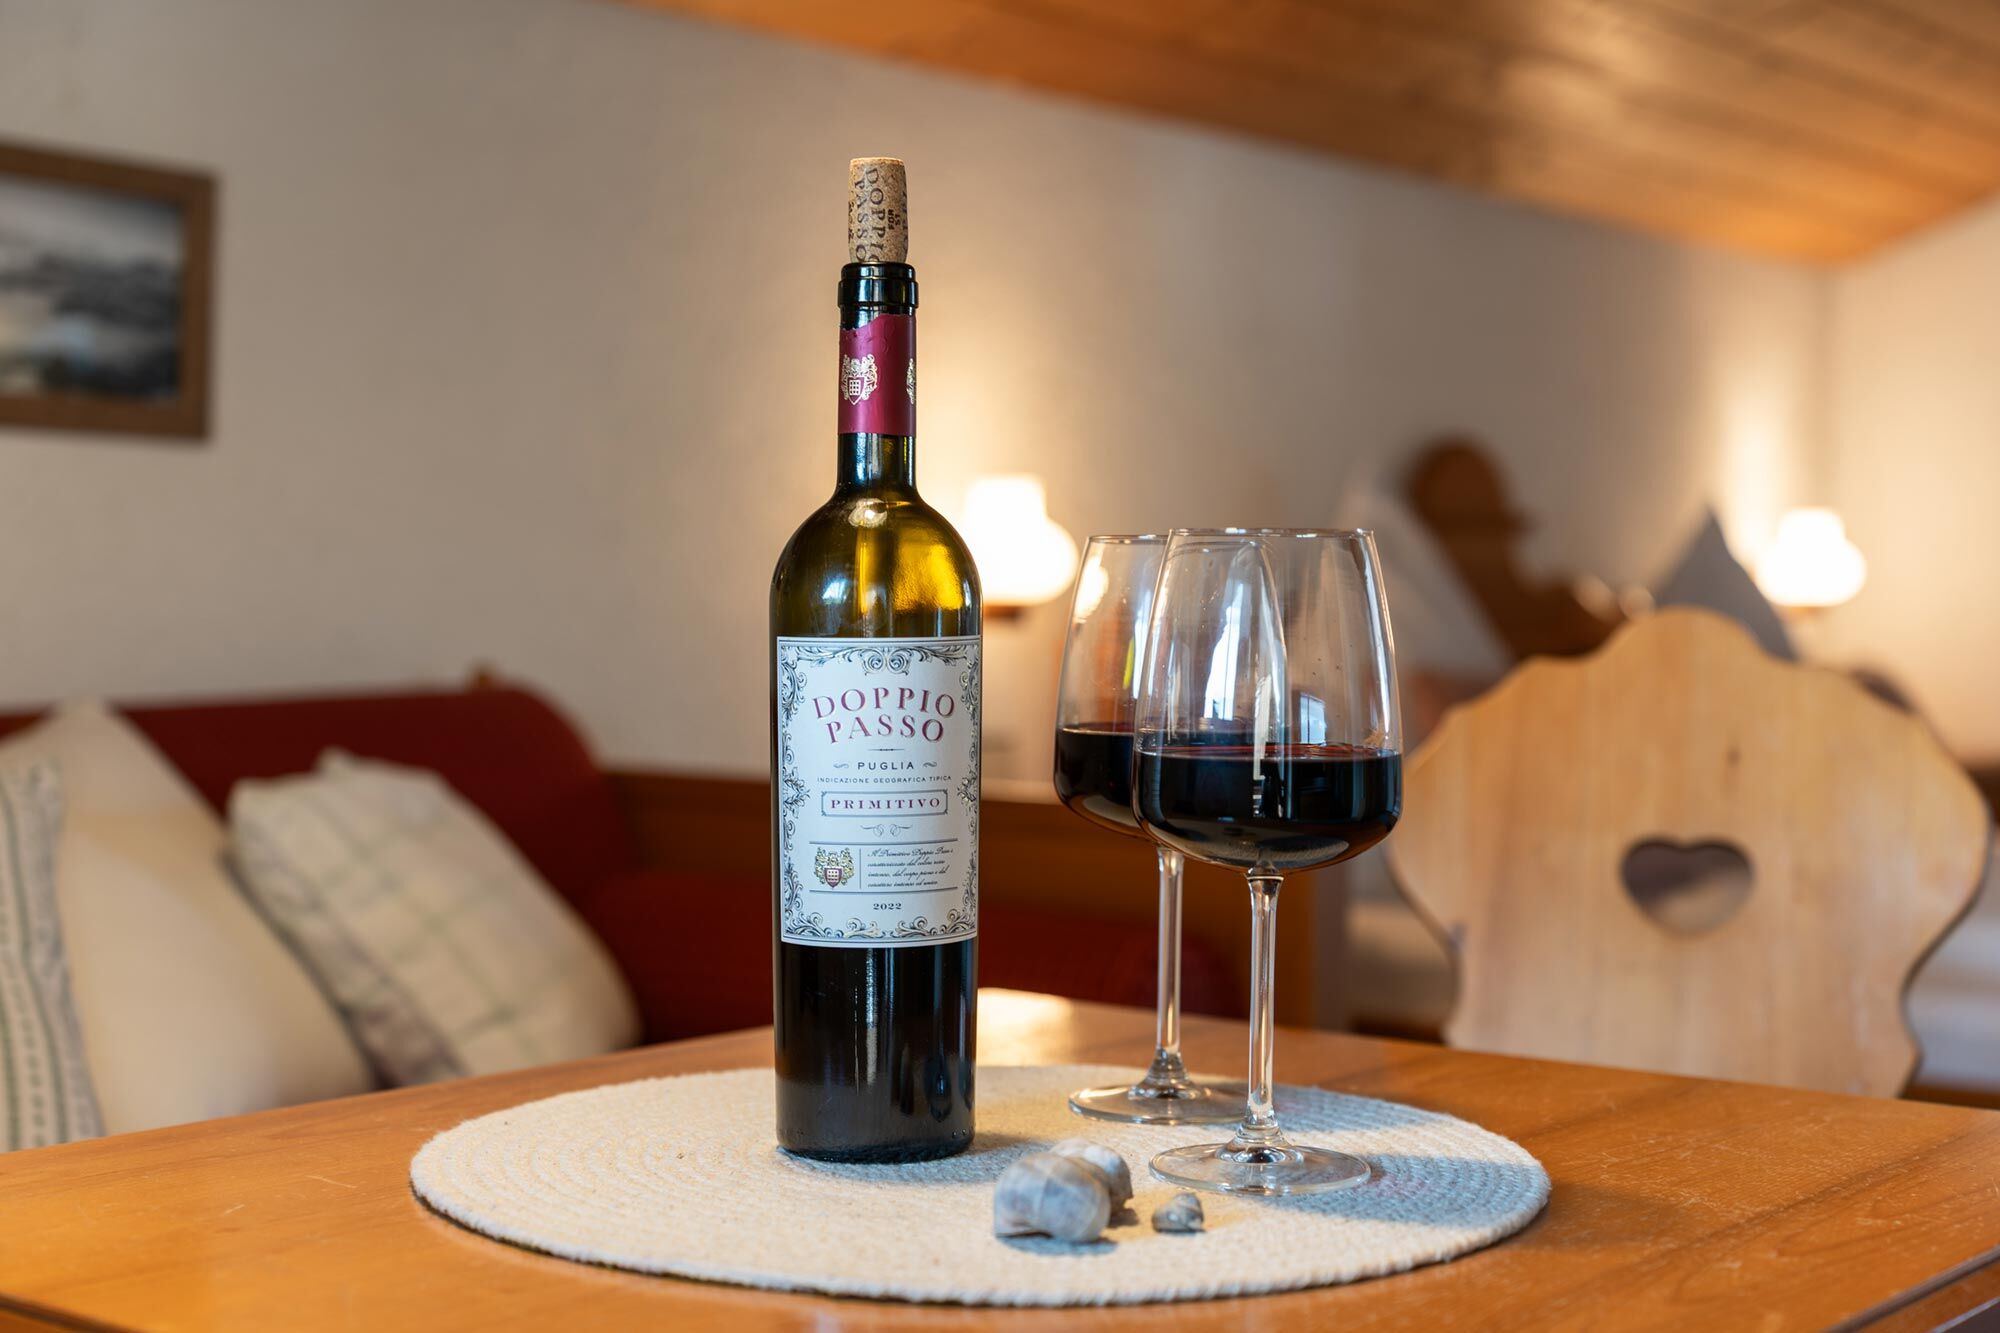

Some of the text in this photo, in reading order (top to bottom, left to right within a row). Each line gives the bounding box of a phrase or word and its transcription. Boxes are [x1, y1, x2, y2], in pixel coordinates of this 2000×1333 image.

[854, 179, 868, 262] PASSO
[813, 687, 955, 719] DOPPIO
[826, 713, 945, 744] PASSO
[857, 761, 915, 771] PUGLIA
[831, 798, 940, 809] PRIMITIVO
[873, 902, 902, 911] 2022
